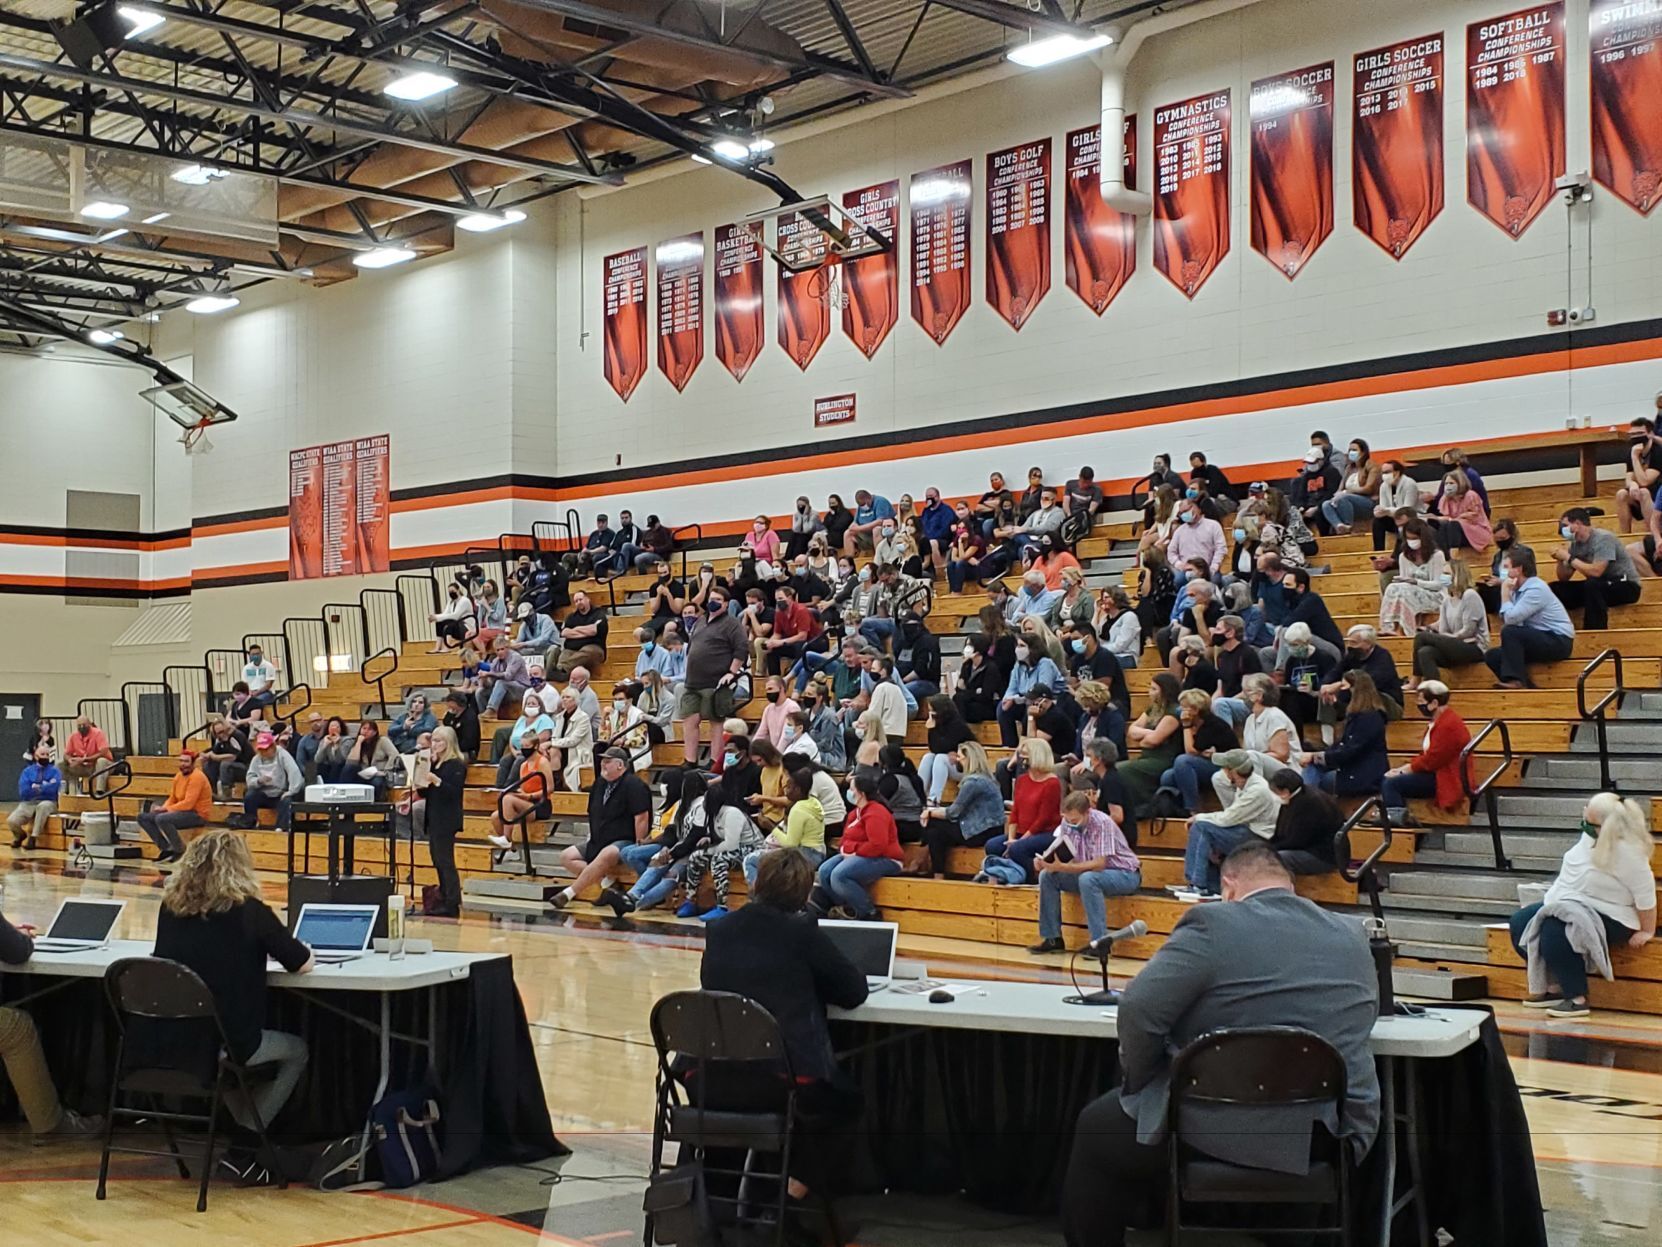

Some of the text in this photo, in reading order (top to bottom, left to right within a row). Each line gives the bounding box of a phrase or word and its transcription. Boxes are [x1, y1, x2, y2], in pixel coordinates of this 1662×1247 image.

[1480, 11, 1550, 40] SOFTBALL
[1485, 28, 1544, 50] CONFERENCE
[1603, 25, 1662, 47] CHAMPIONS
[1356, 40, 1441, 72] GIRLS SOCCER
[1477, 36, 1552, 63] CHAMPIONSHIPS
[1600, 42, 1655, 64] 1996 1997
[1371, 58, 1425, 79] CONFERENCE
[1476, 66, 1497, 78] 1984
[1532, 51, 1555, 64] 1987
[1286, 68, 1331, 88] SOCCER
[1364, 66, 1432, 91] CHAMPIONSHIPS
[1476, 76, 1498, 89] 1989
[1360, 94, 1380, 106] 2013
[1415, 80, 1436, 93] 2015
[1156, 96, 1227, 124] GYMNASTICS
[1360, 105, 1380, 117] 2016
[1163, 120, 1220, 142] CHAMPIONSHIPS
[1168, 112, 1214, 132] CONFERENCE
[1260, 121, 1277, 131] 1994
[1073, 130, 1101, 147] GIRLS
[995, 145, 1044, 168] BOYS GOLF
[1160, 155, 1178, 166] 2010
[1204, 144, 1222, 154] 2012
[1160, 165, 1178, 176] 2013
[1204, 152, 1222, 163] 2015
[994, 167, 1043, 186] CHAMPIONSHIPS
[999, 159, 1038, 176] CONFERENCE
[1160, 162, 1222, 185] 2016 2017 2018
[860, 190, 879, 203] GIRLS
[1160, 183, 1178, 194] 2019
[866, 196, 899, 213] COUNTRY
[779, 223, 798, 236] CROSS
[609, 252, 641, 269] BASEBALL
[820, 410, 849, 421] STUDENTS
[337, 443, 353, 452] STATE
[372, 437, 387, 446] STATE
